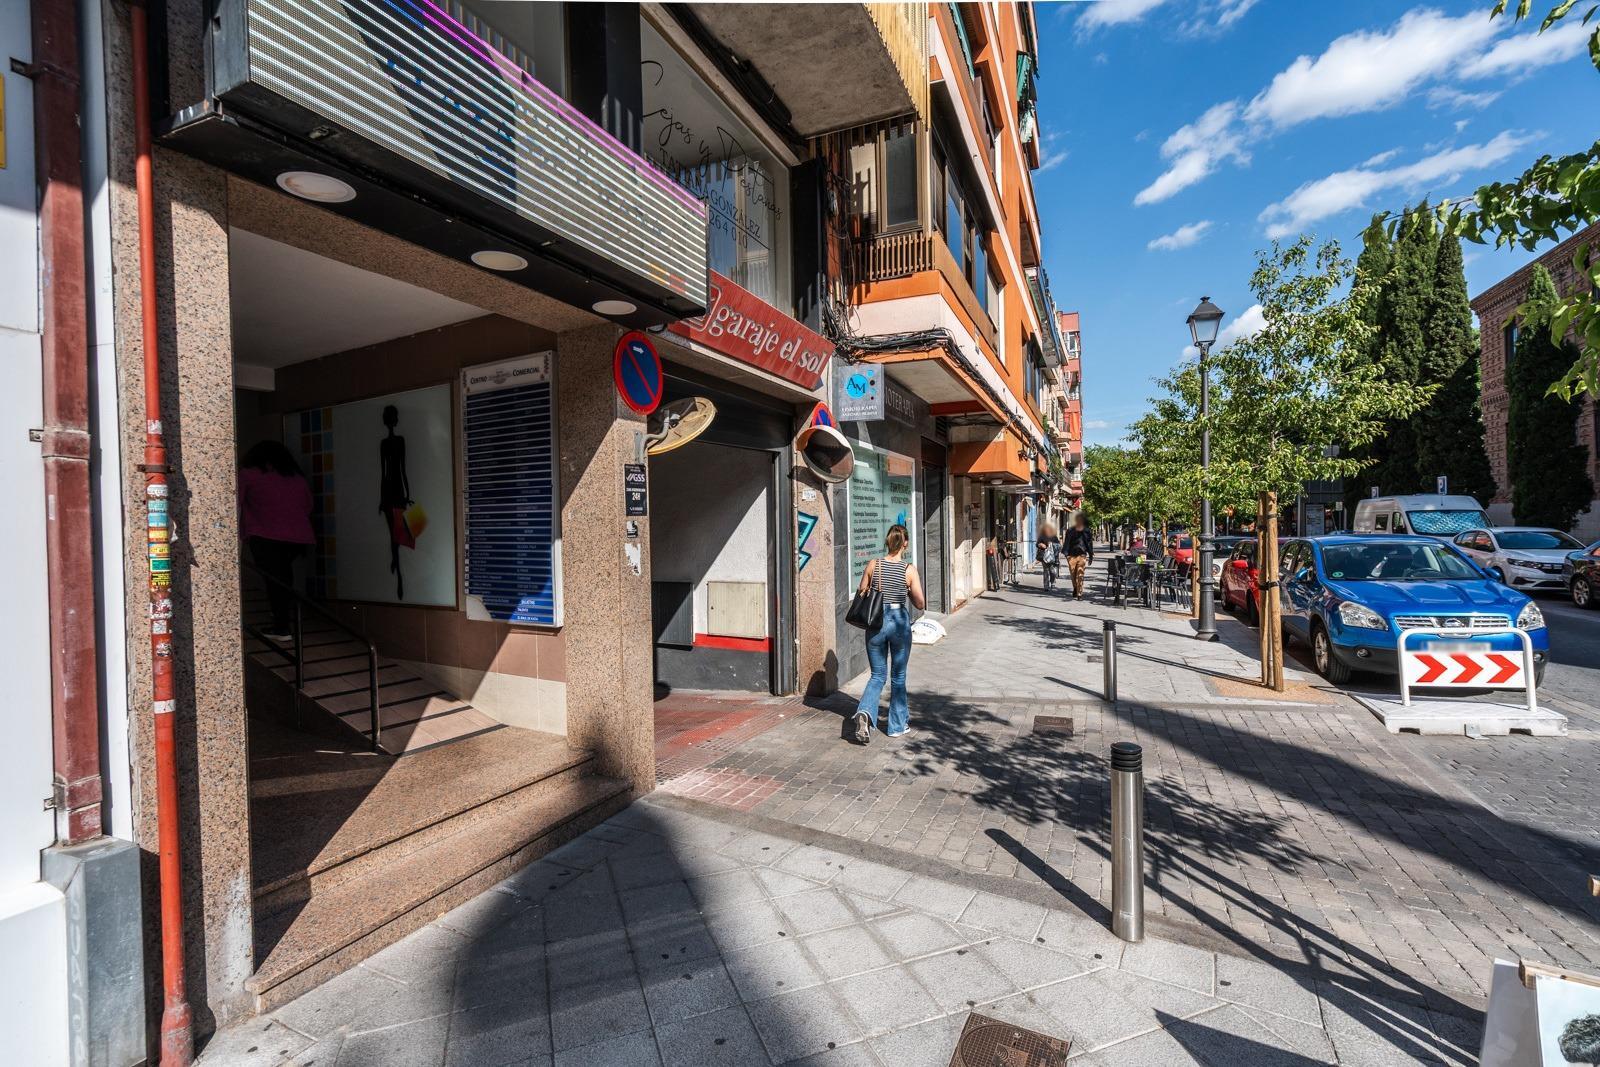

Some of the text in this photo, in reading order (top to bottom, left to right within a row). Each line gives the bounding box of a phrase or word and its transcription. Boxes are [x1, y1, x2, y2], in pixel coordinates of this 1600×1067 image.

[710, 189, 761, 240] GONZALEZ
[708, 304, 828, 375] garaje el sol
[847, 377, 866, 394] AM
[885, 386, 915, 420] IOTERAPIA
